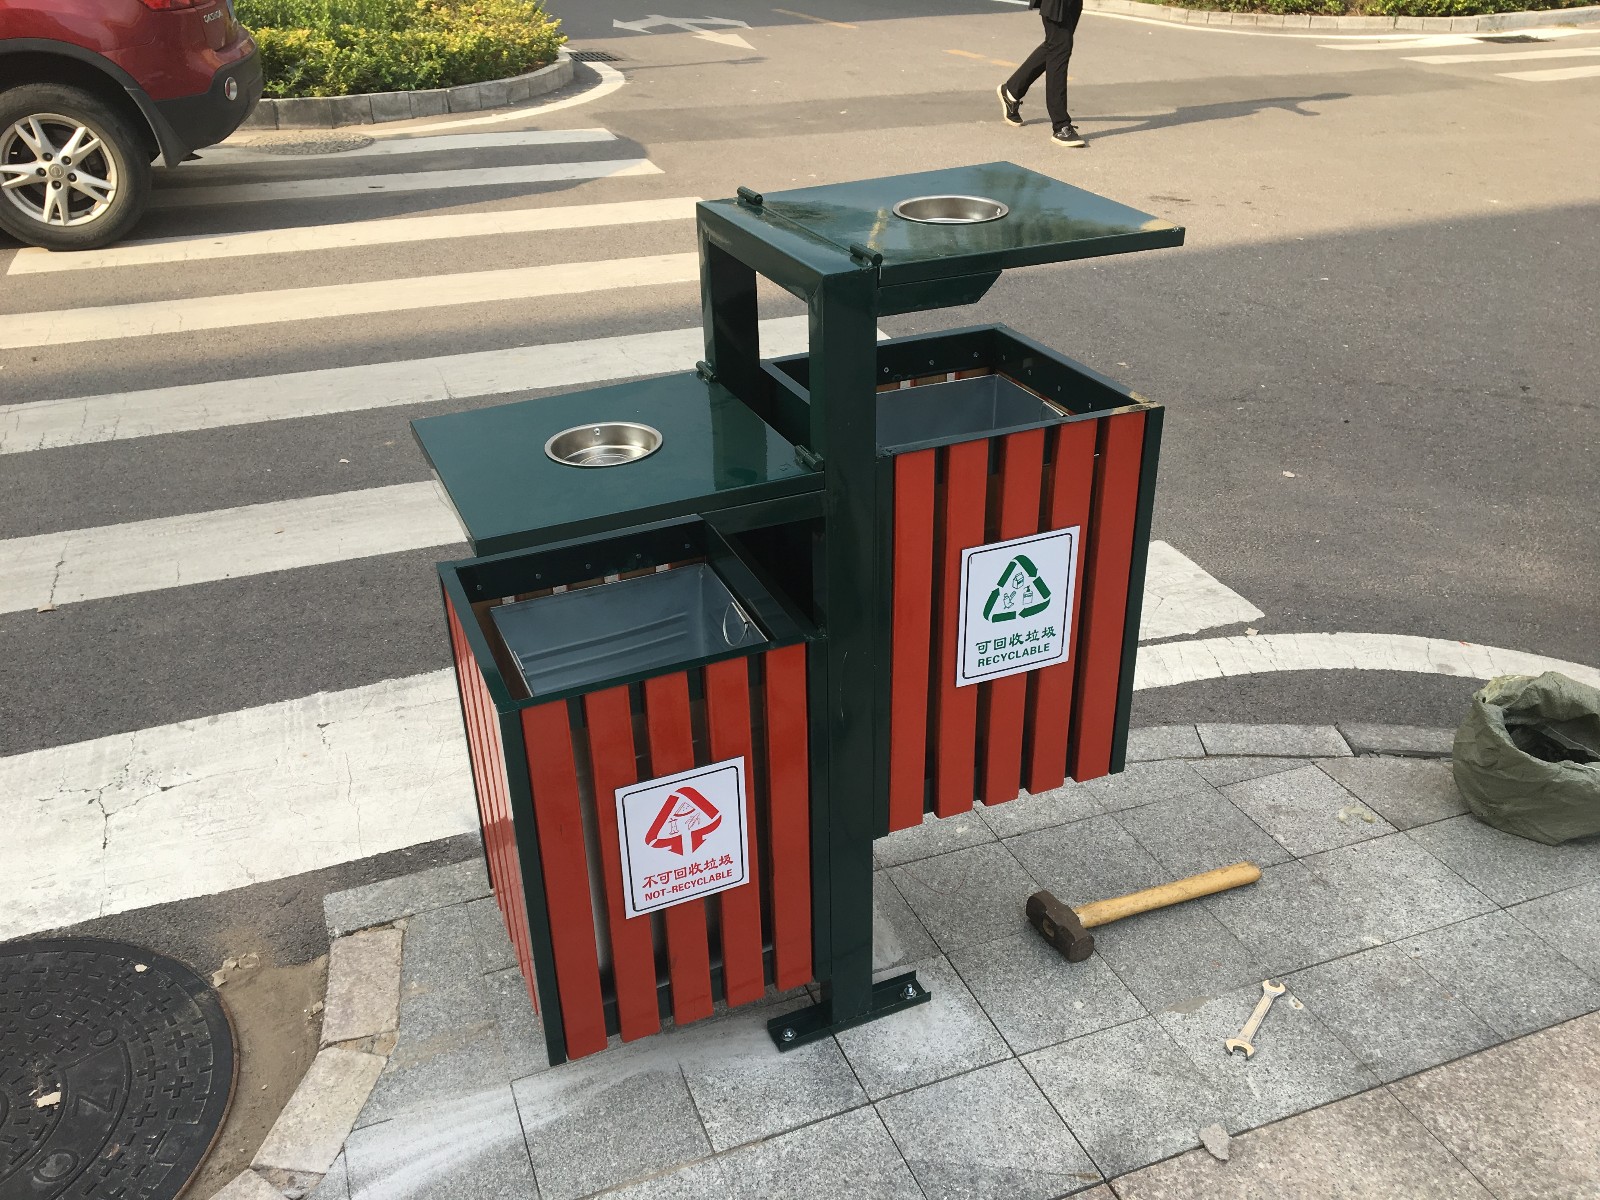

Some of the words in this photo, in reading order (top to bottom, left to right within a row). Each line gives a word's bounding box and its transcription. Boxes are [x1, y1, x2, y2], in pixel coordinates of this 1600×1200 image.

[975, 626, 1057, 655] 可回收垃圾
[977, 643, 1051, 667] RECYCLABLE
[642, 853, 734, 889] 不可回收垃圾
[645, 869, 733, 901] NOT-RECYCLABLE
